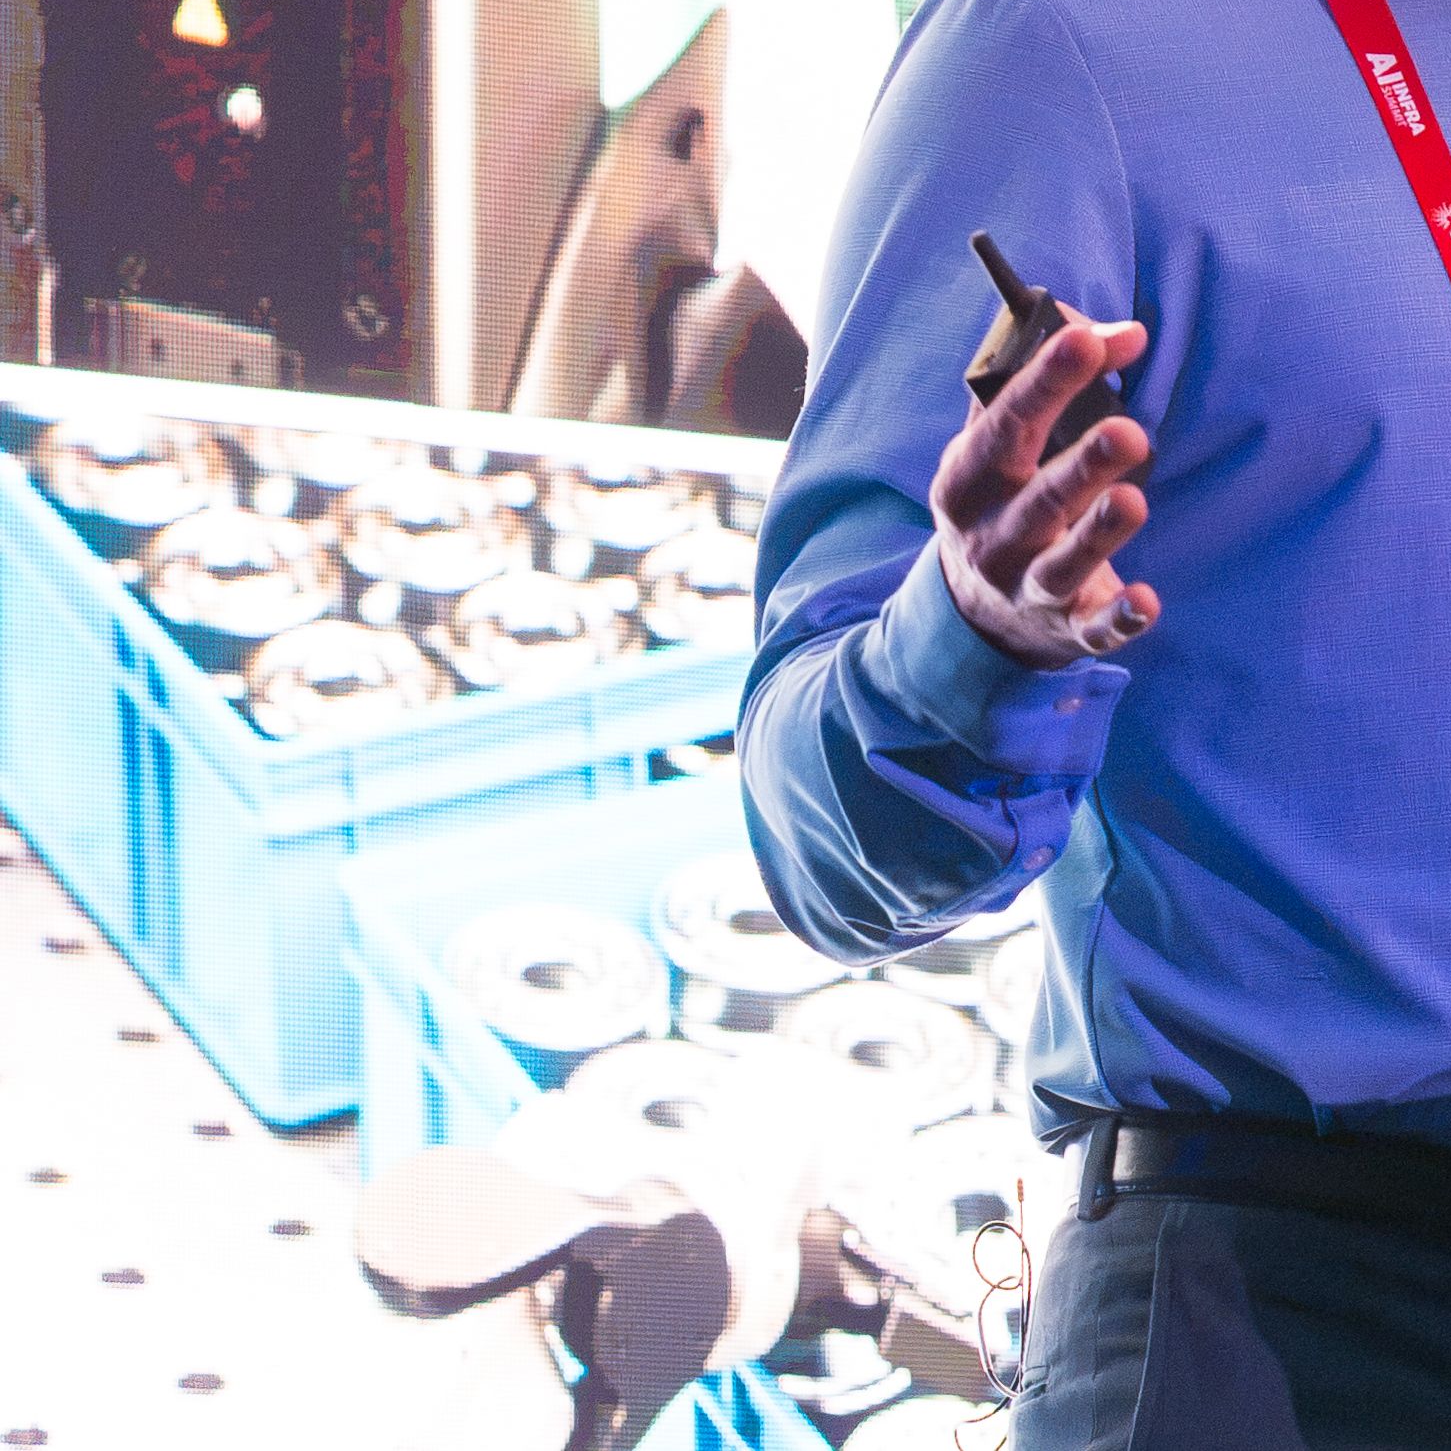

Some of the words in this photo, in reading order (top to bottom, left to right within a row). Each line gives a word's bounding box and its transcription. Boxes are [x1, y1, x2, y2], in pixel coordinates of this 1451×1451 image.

[1365, 53, 1405, 86] AI
[1391, 81, 1426, 137] INFRA
[1380, 85, 1408, 128] SUMMIT
